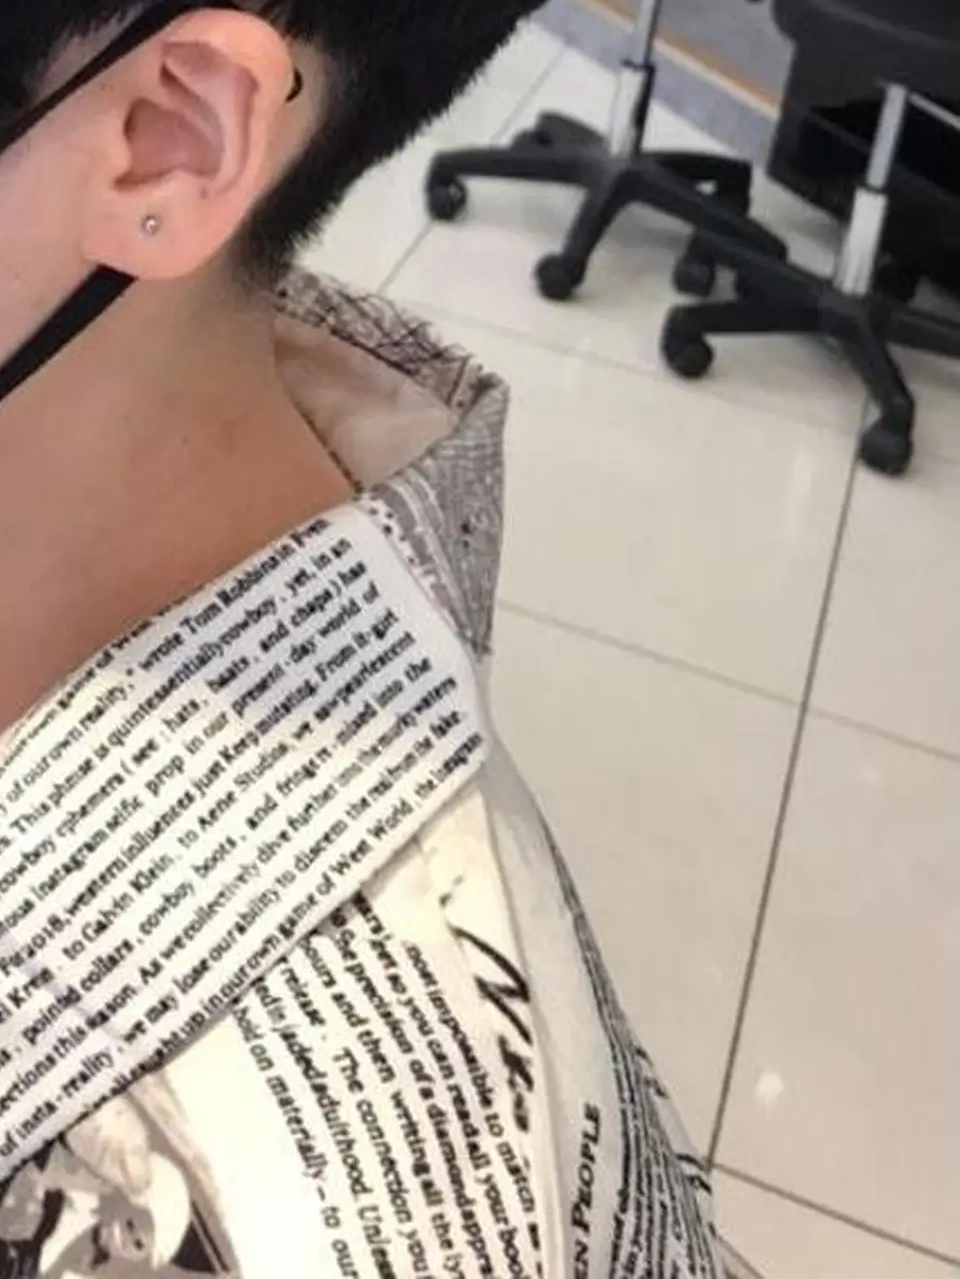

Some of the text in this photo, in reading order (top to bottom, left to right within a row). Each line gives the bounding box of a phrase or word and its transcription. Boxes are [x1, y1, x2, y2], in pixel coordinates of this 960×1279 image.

[135, 879, 197, 937] cowboy
[243, 793, 280, 831] and
[403, 655, 433, 683] the
[143, 754, 187, 798] prop
[51, 1024, 89, 1059] this
[137, 957, 164, 986] As
[330, 989, 370, 1030] and
[397, 994, 435, 1039] you
[356, 1028, 397, 1085] then
[425, 1038, 456, 1081] can
[444, 1082, 481, 1143] read
[482, 1111, 506, 1139] to
[249, 1043, 275, 1072] on
[320, 1204, 343, 1230] to
[464, 1139, 491, 1171] all
[332, 1046, 367, 1095] The
[396, 1227, 431, 1279] you
[418, 1177, 445, 1208] all
[475, 1173, 512, 1228] your
[429, 1211, 456, 1252] the
